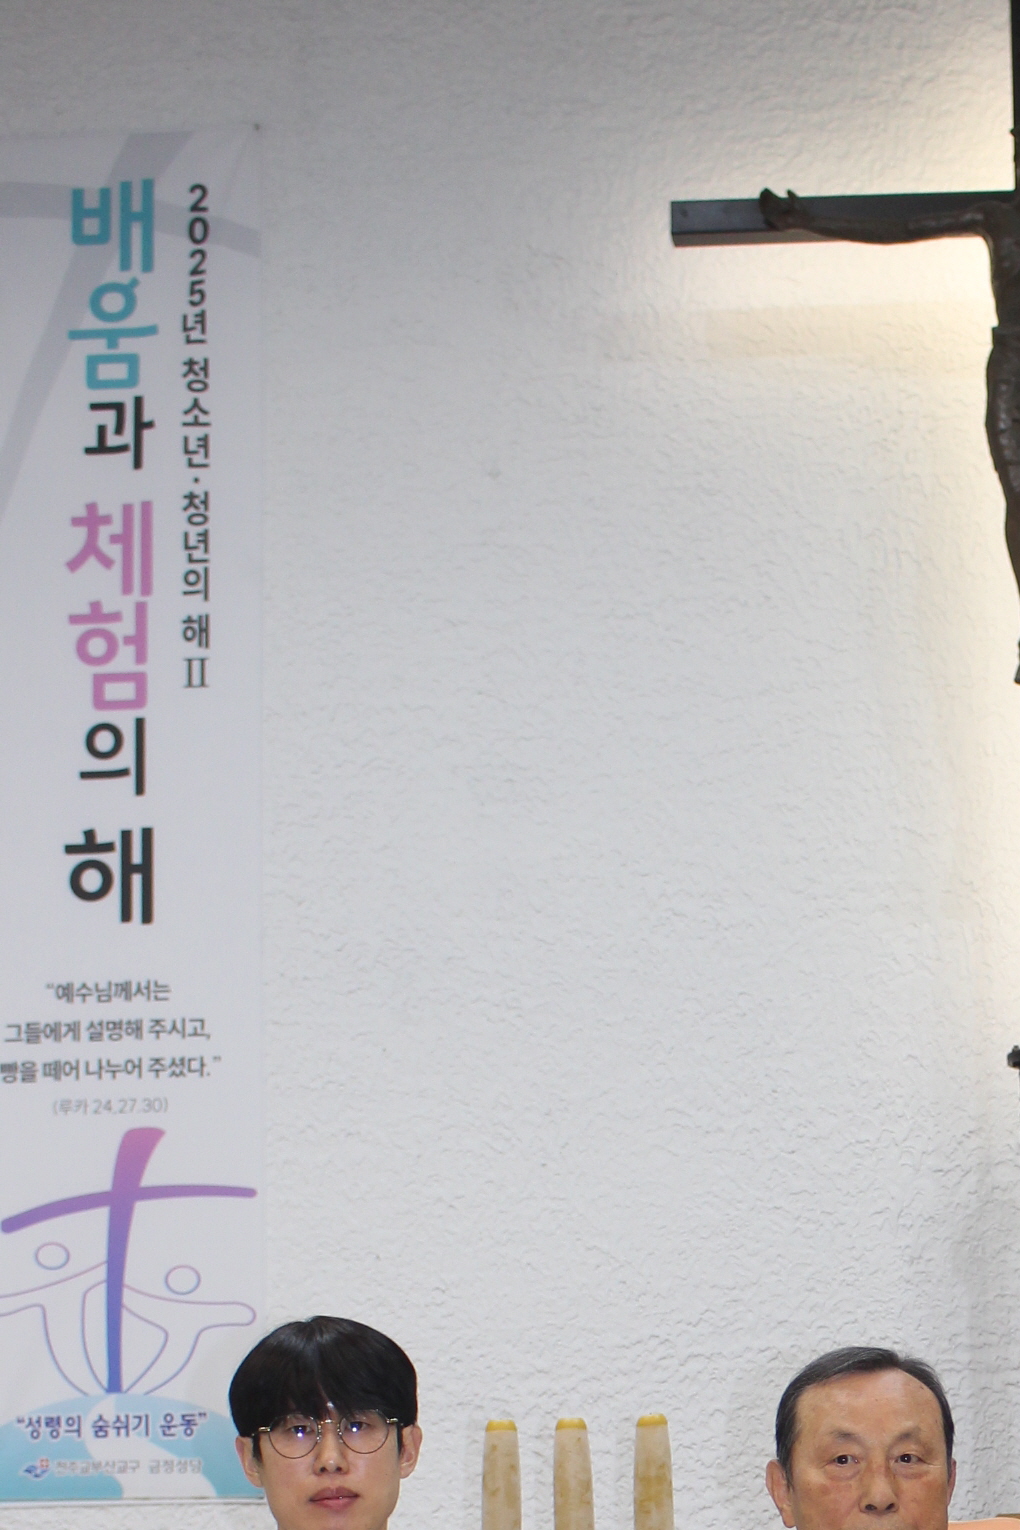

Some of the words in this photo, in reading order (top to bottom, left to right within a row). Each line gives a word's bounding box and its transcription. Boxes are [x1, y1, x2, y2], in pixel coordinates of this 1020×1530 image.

[182, 183, 210, 345] 2025년
[67, 178, 158, 470] 배움과
[181, 357, 211, 602] 청소년·청년의
[65, 500, 153, 796] 체험의
[182, 613, 210, 649] 해
[64, 827, 153, 925] 해
[46, 979, 171, 1004] “예수님께서는
[5, 1020, 81, 1044] 그들에게
[86, 1019, 143, 1042] 설명해
[148, 1017, 211, 1040] 주시고,
[0, 1061, 38, 1084] 빵을
[42, 1058, 80, 1081] 떼어
[85, 1057, 143, 1079] 나누어
[53, 1098, 88, 1115] (루카
[17, 1414, 82, 1440] “성령의
[92, 1413, 149, 1439] 숨쉬기
[159, 1411, 207, 1437] 운동”
